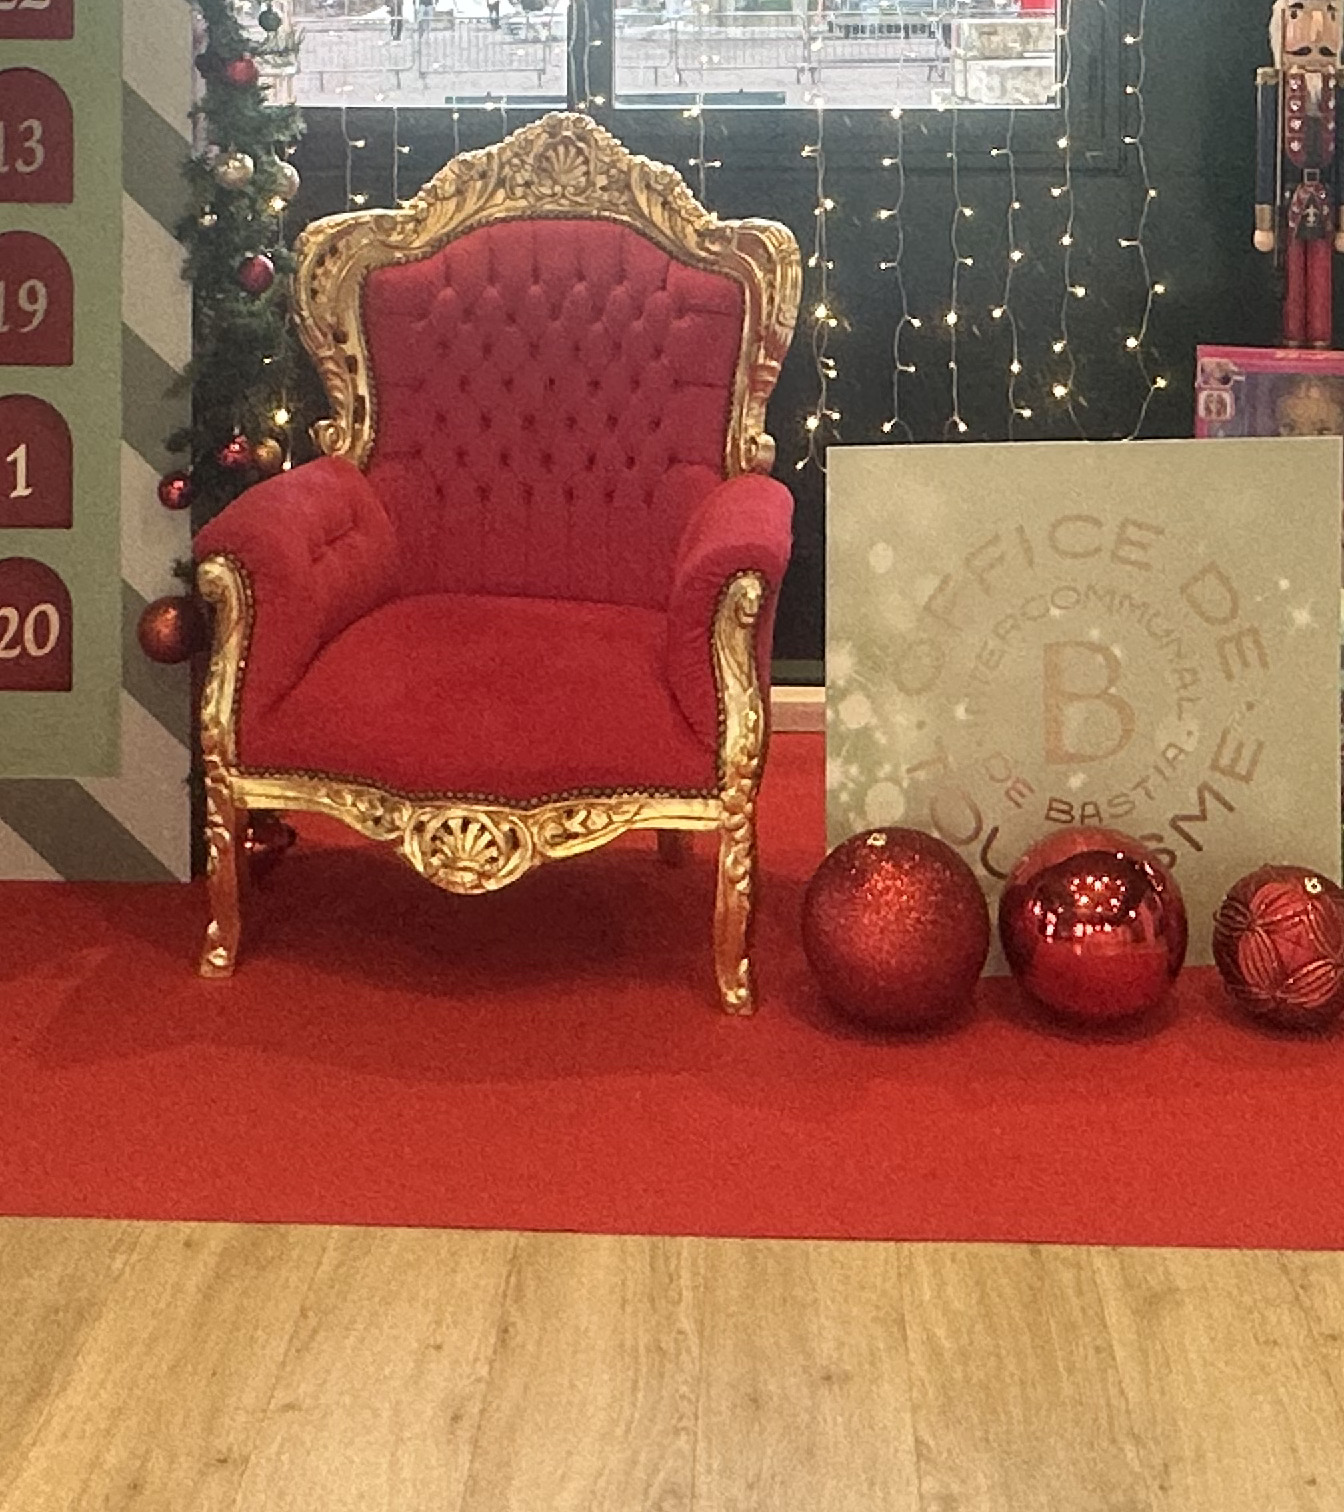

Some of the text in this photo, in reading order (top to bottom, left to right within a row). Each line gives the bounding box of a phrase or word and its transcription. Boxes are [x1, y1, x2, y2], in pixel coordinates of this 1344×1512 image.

[7, 444, 32, 497] 1
[894, 514, 1270, 880] OFFICE DE TOUSME
[1043, 640, 1135, 765] B
[983, 751, 1035, 810] DE
[1044, 742, 1192, 824] BASTIA
